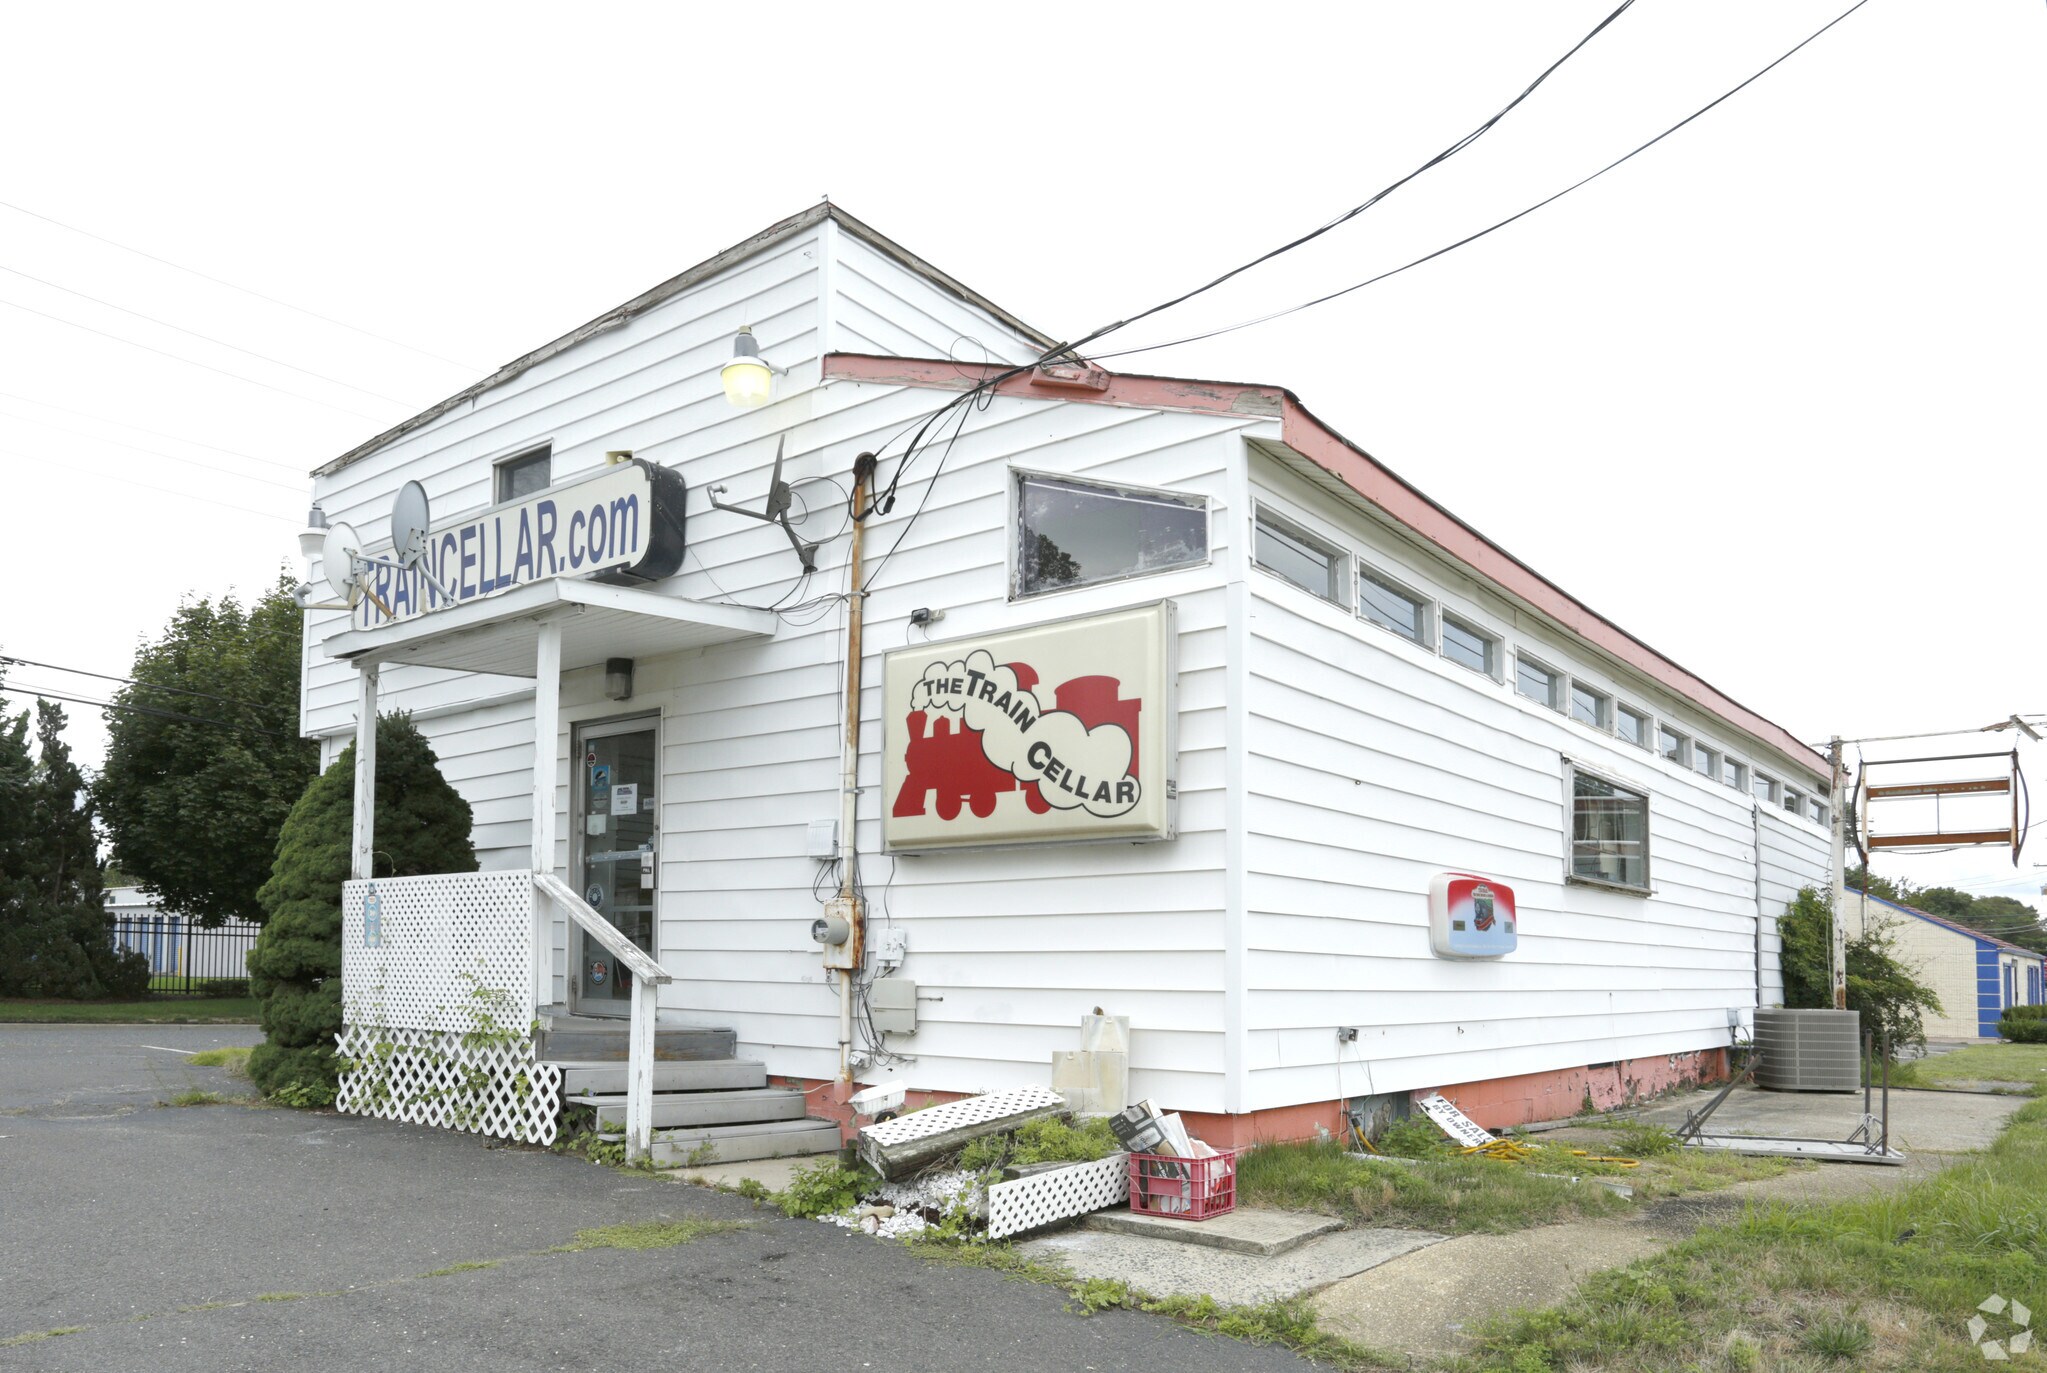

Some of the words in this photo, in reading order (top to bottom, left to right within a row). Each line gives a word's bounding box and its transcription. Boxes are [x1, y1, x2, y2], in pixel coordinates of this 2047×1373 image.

[923, 677, 964, 697] THE
[966, 669, 1037, 733] TRAIN
[1027, 741, 1134, 804] CELLAR
[1432, 1104, 1446, 1114] BY
[1446, 1117, 1482, 1144] OWNER
[1436, 1098, 1460, 1118] FOR
